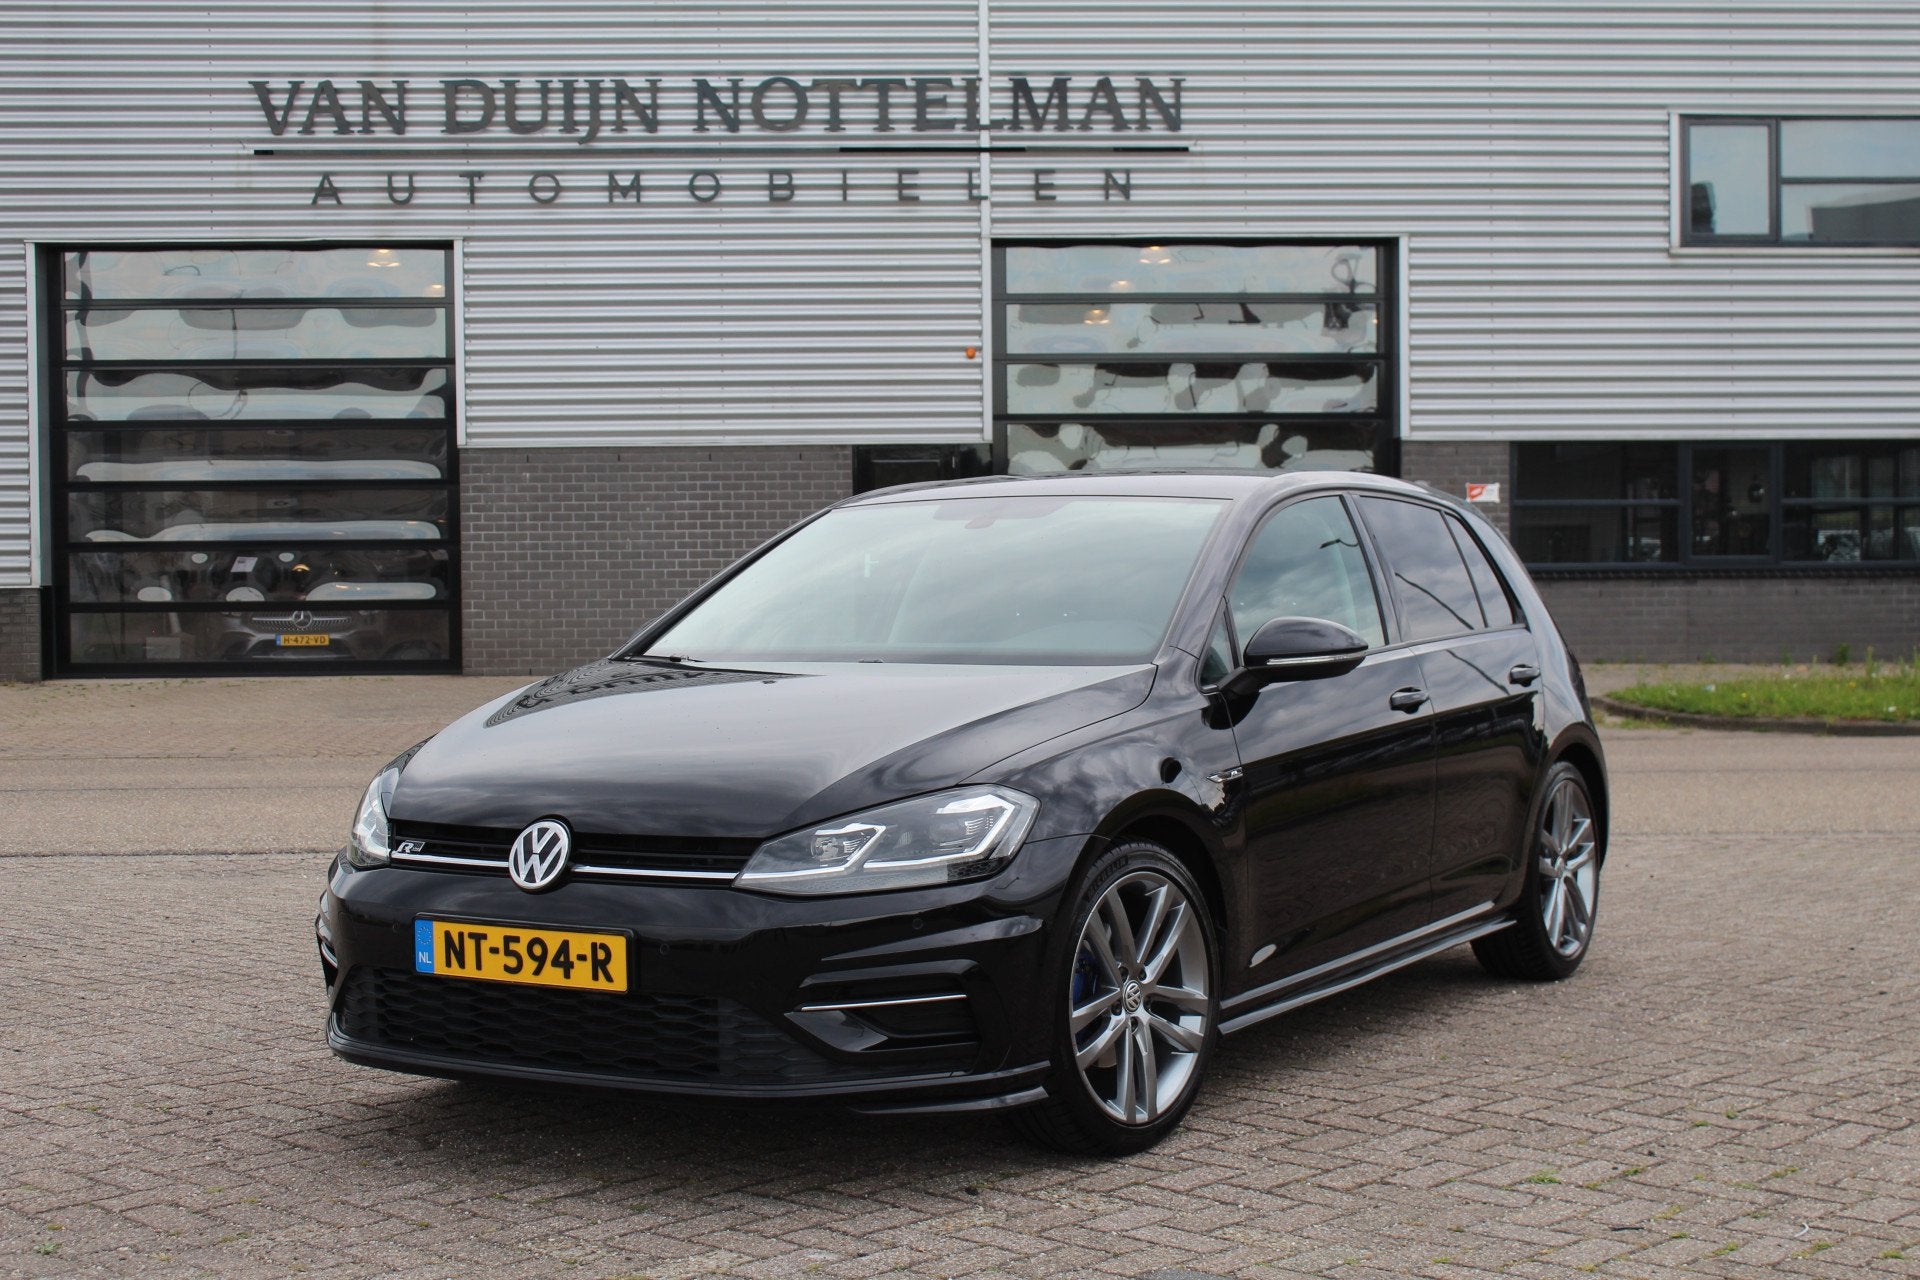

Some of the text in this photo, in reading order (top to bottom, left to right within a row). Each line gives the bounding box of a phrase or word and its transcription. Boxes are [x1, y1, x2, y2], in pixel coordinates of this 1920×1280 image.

[248, 75, 1187, 145] VAN DUIJN NOTTELMAN
[311, 168, 1132, 205] AUTOMOBIELEN
[418, 951, 432, 964] NL
[444, 930, 614, 983] NT-594-R
